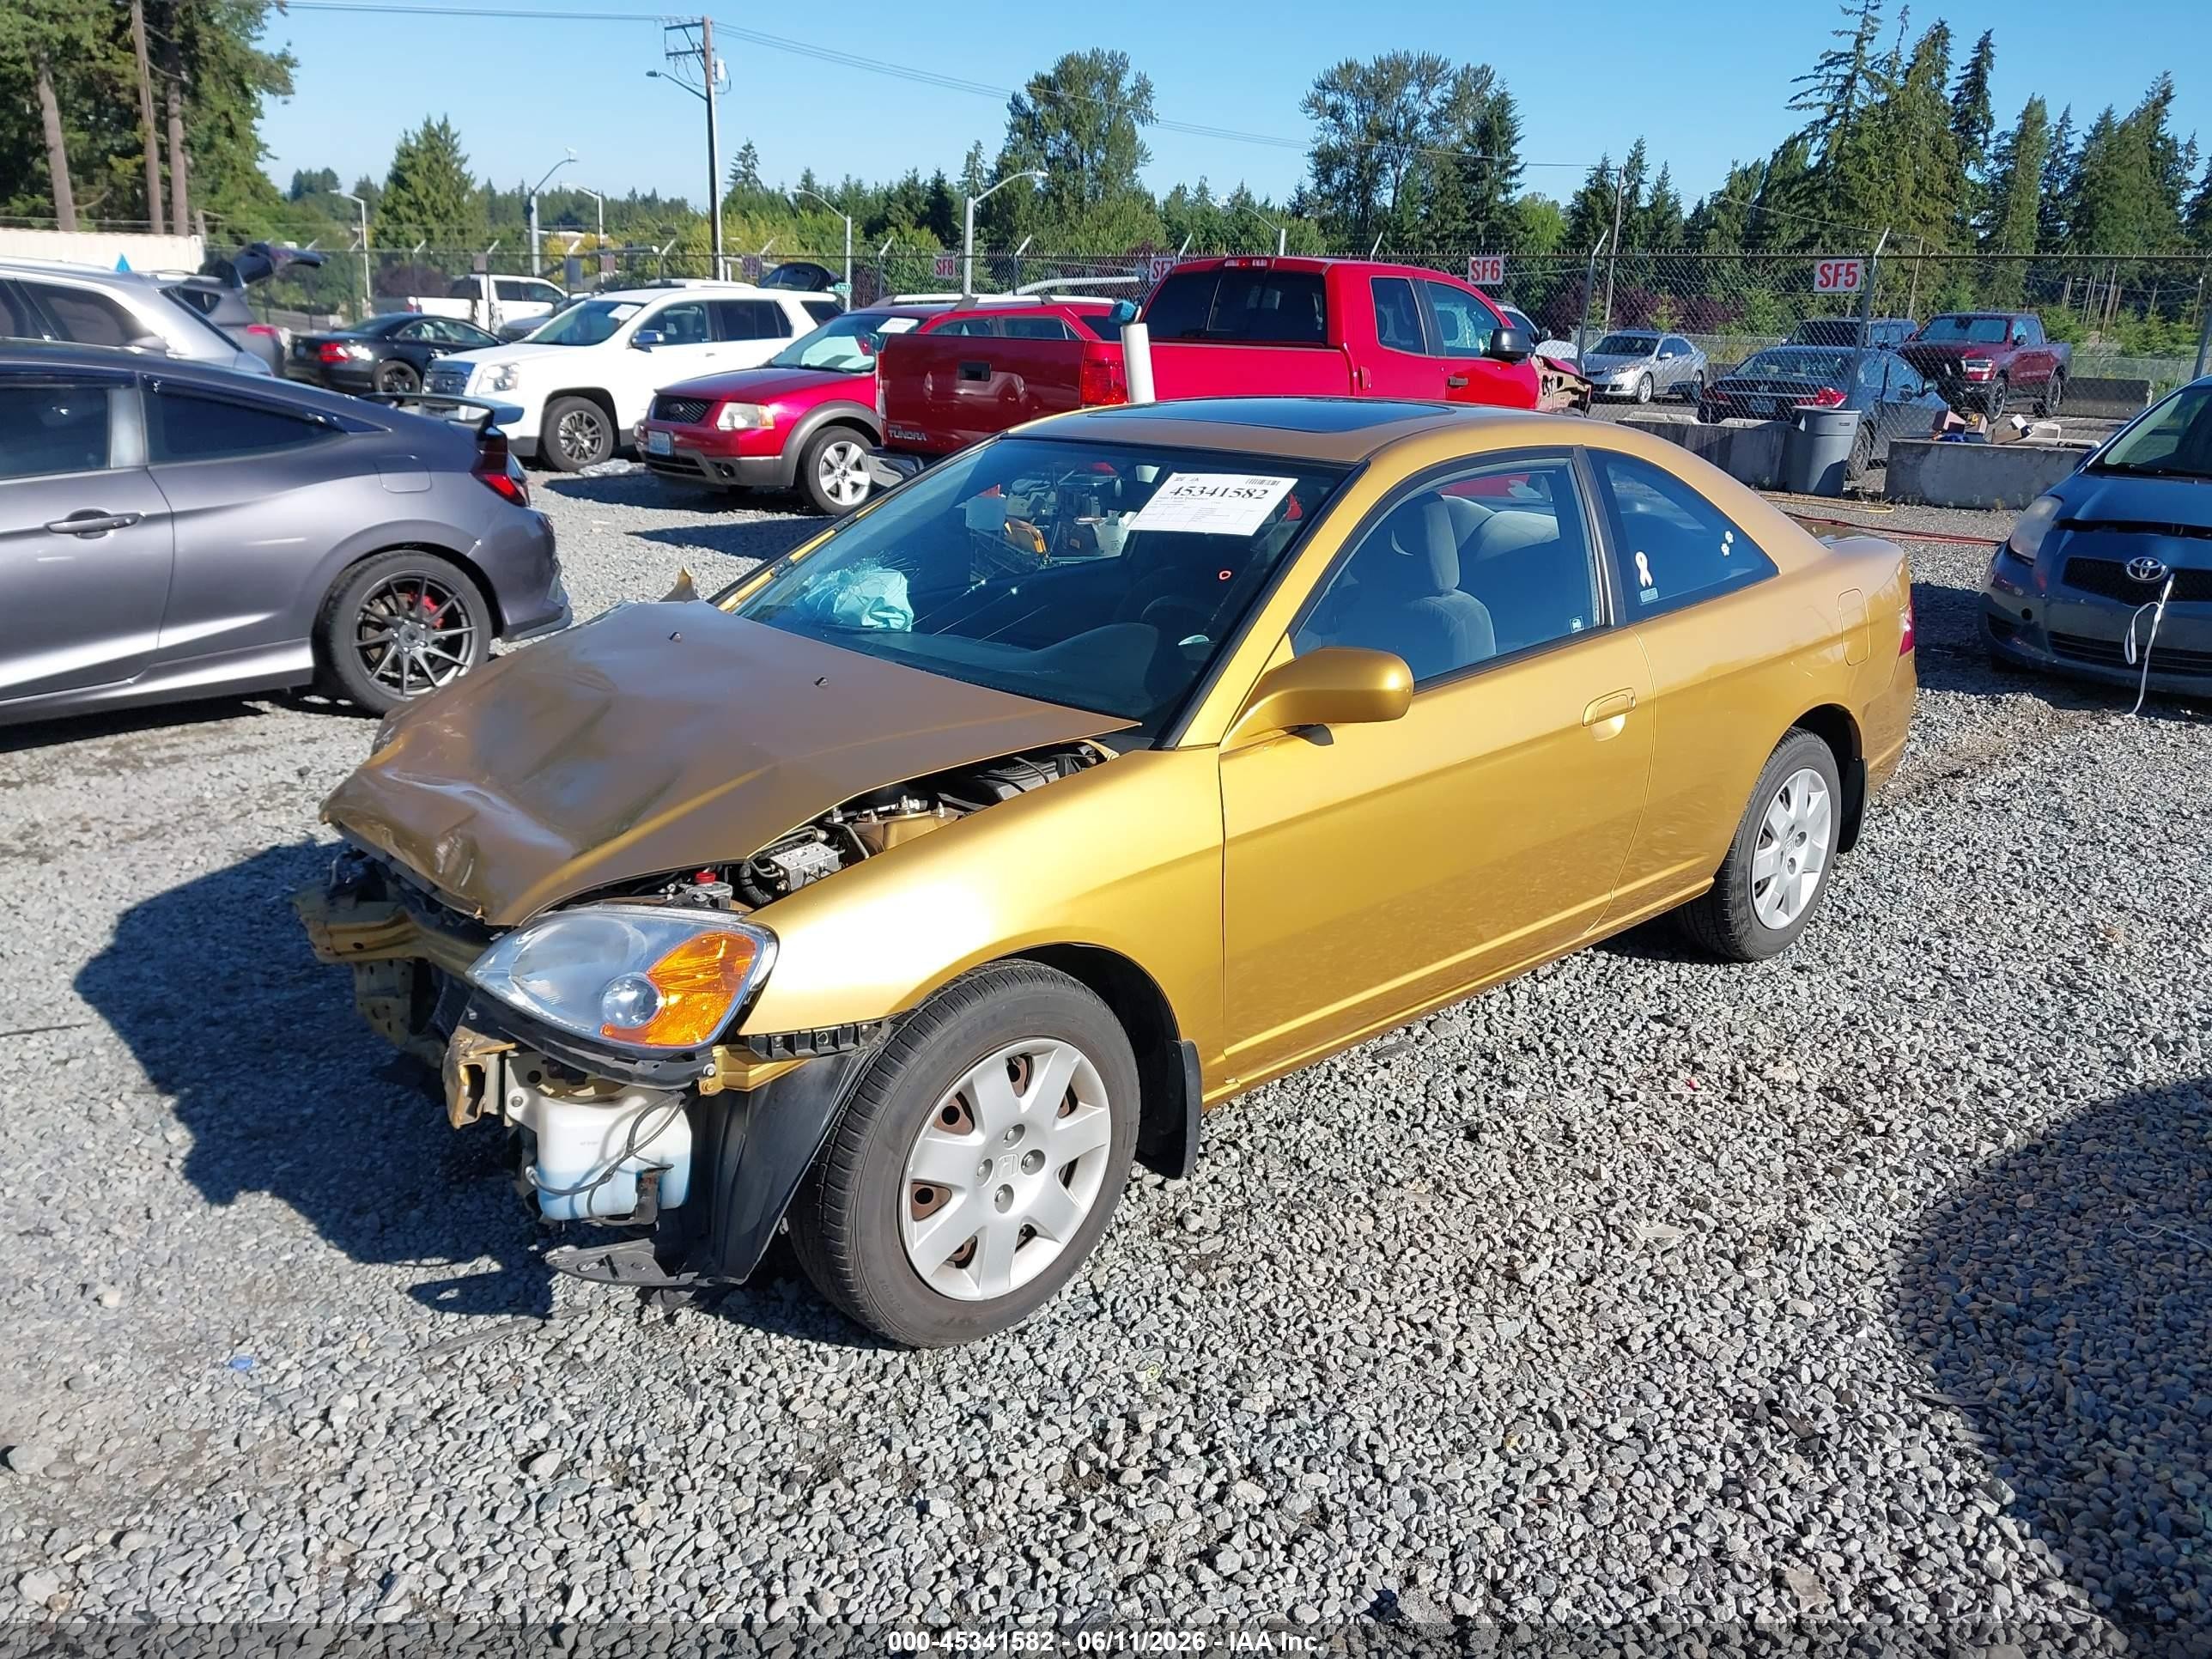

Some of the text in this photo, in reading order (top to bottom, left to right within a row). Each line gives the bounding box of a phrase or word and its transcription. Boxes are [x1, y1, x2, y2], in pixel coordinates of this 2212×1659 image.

[936, 258, 954, 276] SF8
[1470, 259, 1501, 282] SF6
[1818, 263, 1858, 288] SF5
[887, 429, 927, 441] TUNDRA
[1169, 485, 1269, 500] 45341582
